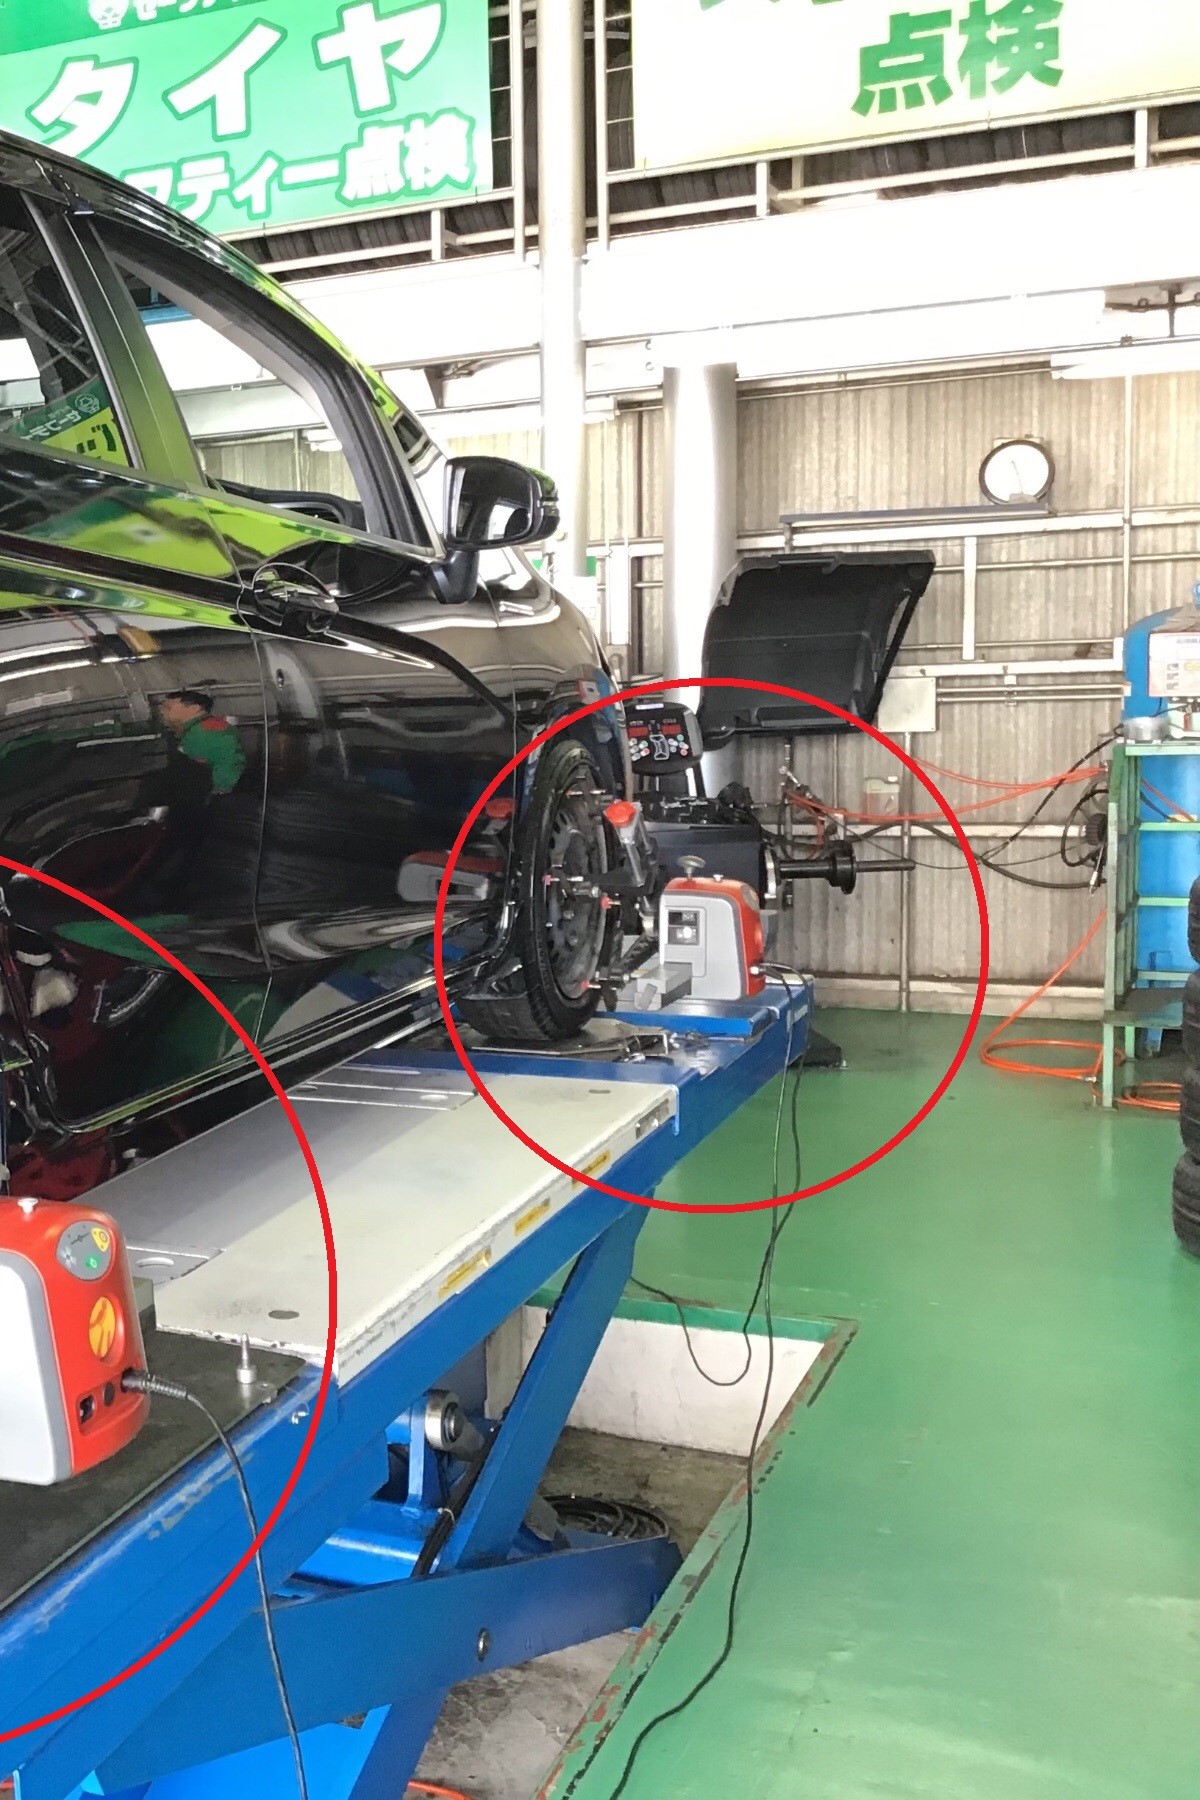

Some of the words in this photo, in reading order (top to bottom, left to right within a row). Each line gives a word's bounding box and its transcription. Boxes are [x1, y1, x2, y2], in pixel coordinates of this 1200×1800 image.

[26, 0, 446, 158] タイヤ
[851, 0, 1064, 117] 点検
